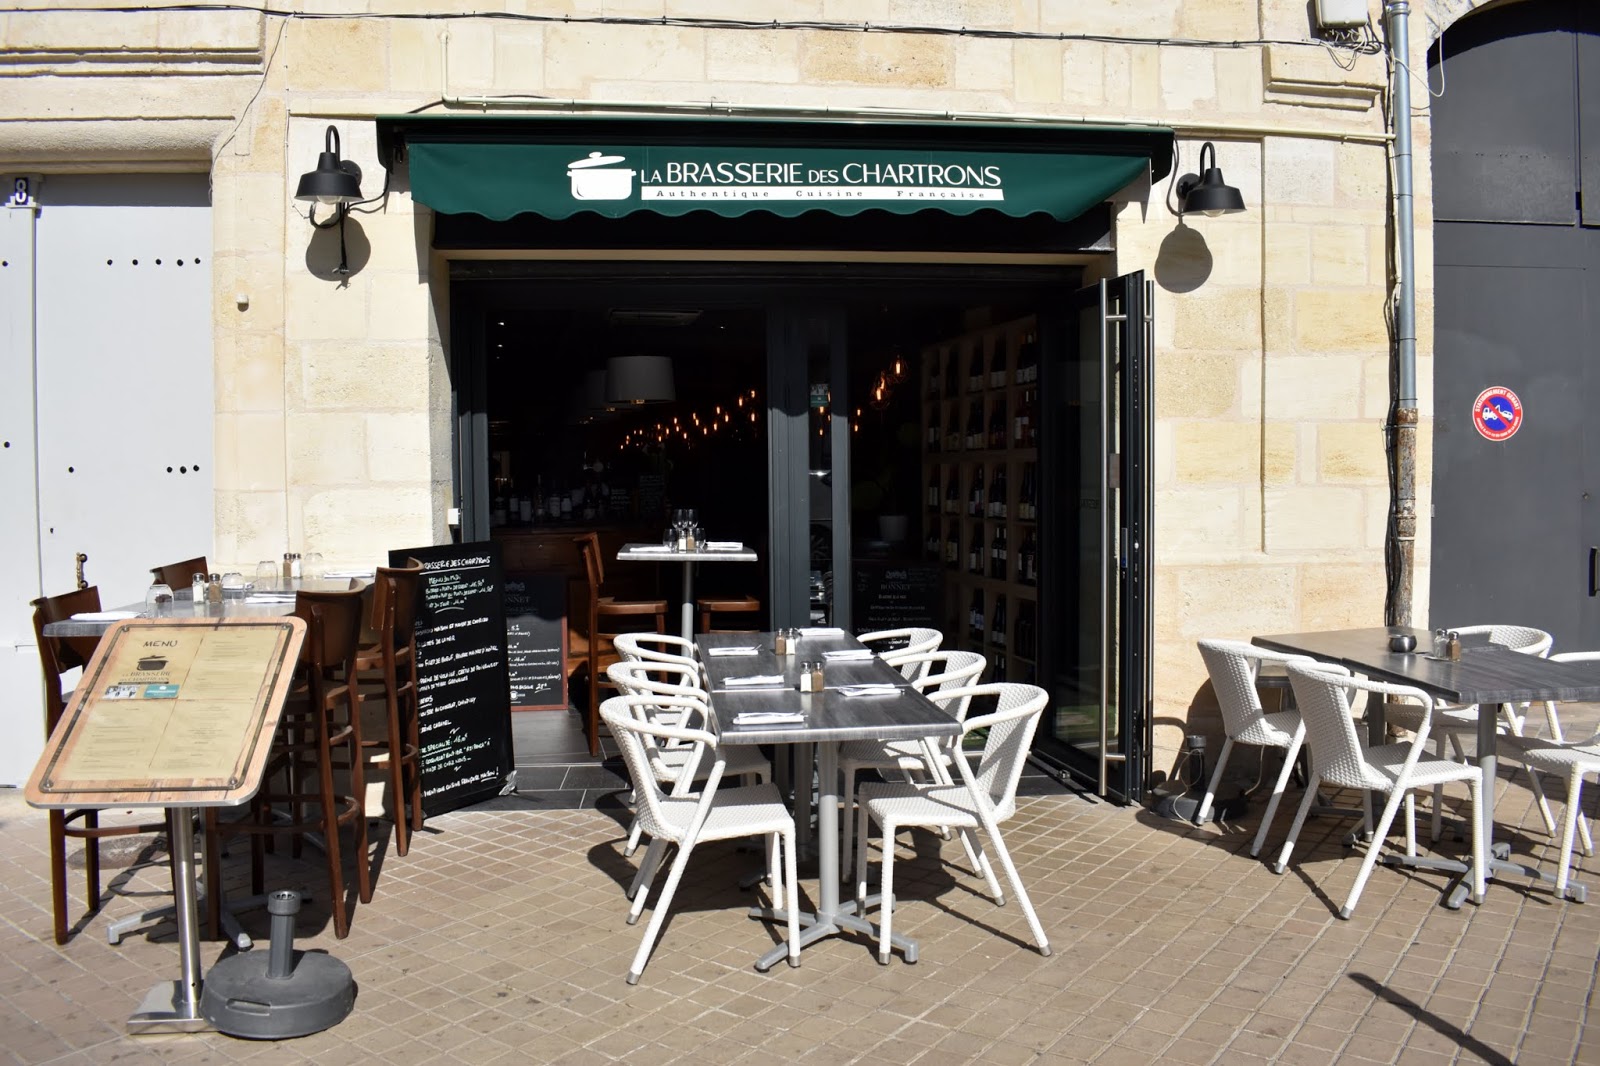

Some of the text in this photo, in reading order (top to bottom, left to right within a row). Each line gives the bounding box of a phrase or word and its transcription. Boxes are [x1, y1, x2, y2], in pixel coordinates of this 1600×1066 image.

[641, 162, 1002, 187] LA BRASSERIE DES CHARTRONS
[15, 179, 27, 203] 8
[656, 190, 769, 198] Authentique
[796, 190, 862, 198] Cuisine
[143, 640, 178, 648] MENU
